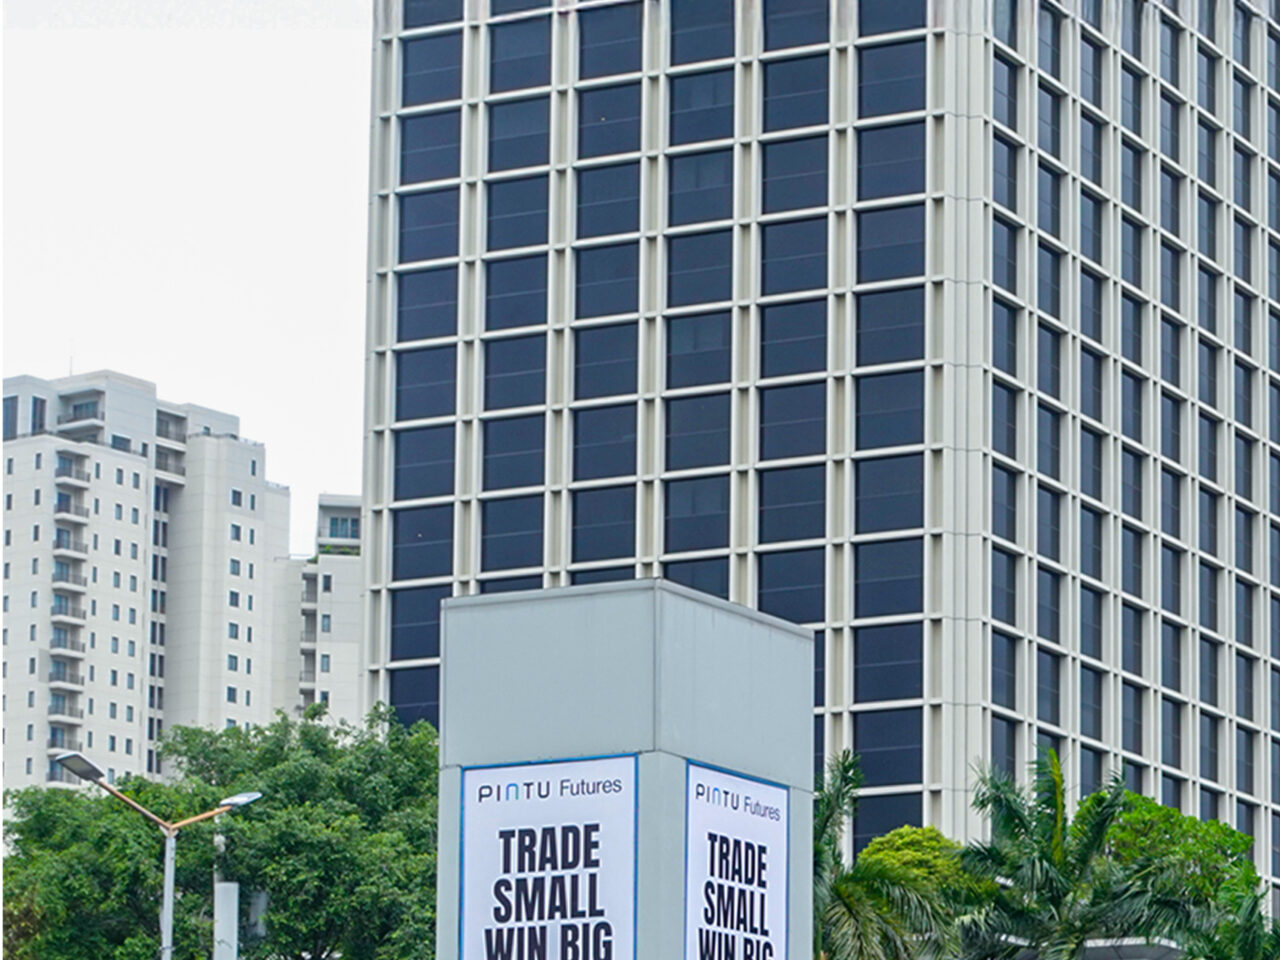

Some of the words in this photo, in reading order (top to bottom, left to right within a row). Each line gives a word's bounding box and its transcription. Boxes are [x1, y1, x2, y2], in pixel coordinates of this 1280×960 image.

[478, 781, 550, 802] PINTU
[560, 778, 622, 797] Futures
[695, 783, 739, 810] PINTU
[744, 796, 780, 822] Futures
[498, 823, 600, 874] TRADE
[708, 832, 767, 889] TRADE
[493, 873, 604, 924] SMALL
[704, 880, 769, 936] SMALL
